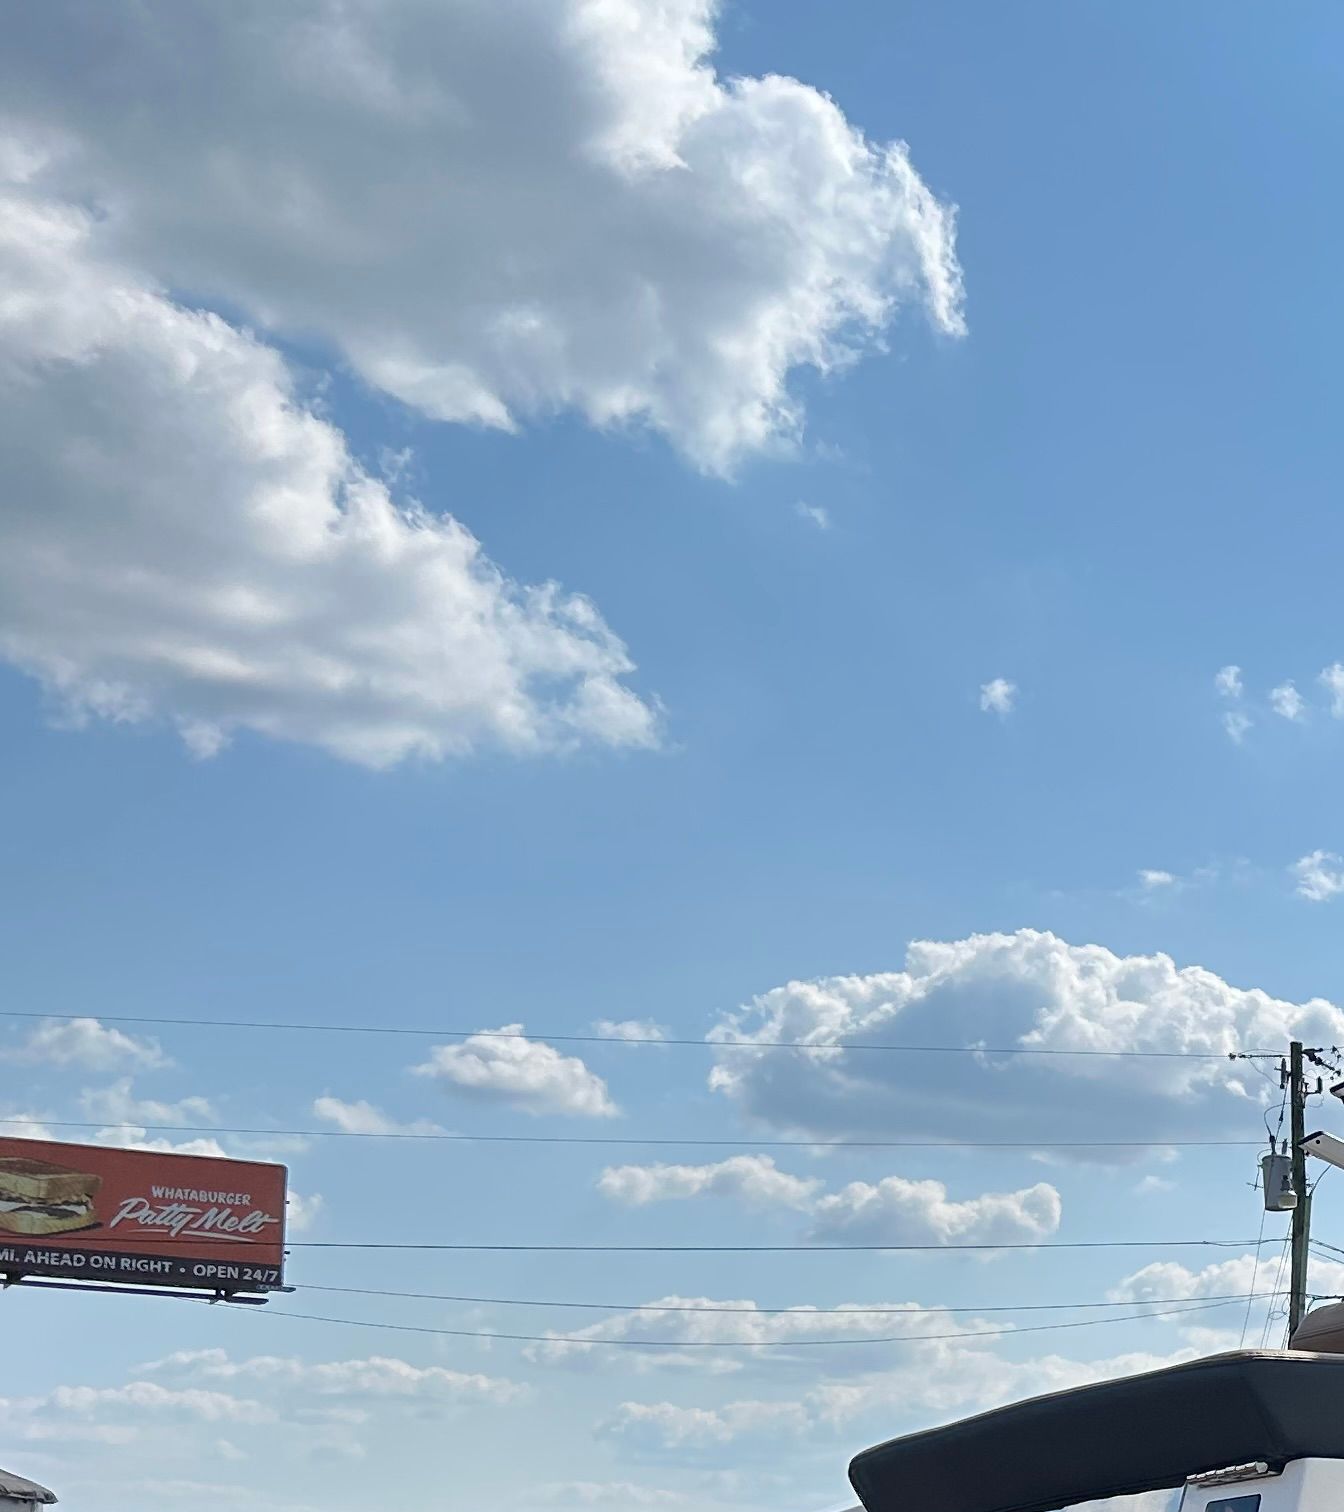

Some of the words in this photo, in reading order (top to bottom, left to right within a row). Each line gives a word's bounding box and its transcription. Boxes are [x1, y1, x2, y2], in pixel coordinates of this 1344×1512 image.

[151, 1185, 251, 1205] WHATABURGER
[110, 1198, 203, 1237] Patty
[191, 1206, 280, 1234] Melt
[24, 1250, 86, 1267] AHEAD
[90, 1254, 117, 1270] ON
[120, 1258, 173, 1274] RIGHT
[193, 1264, 239, 1280] OPEN
[243, 1267, 279, 1283] 24/7
